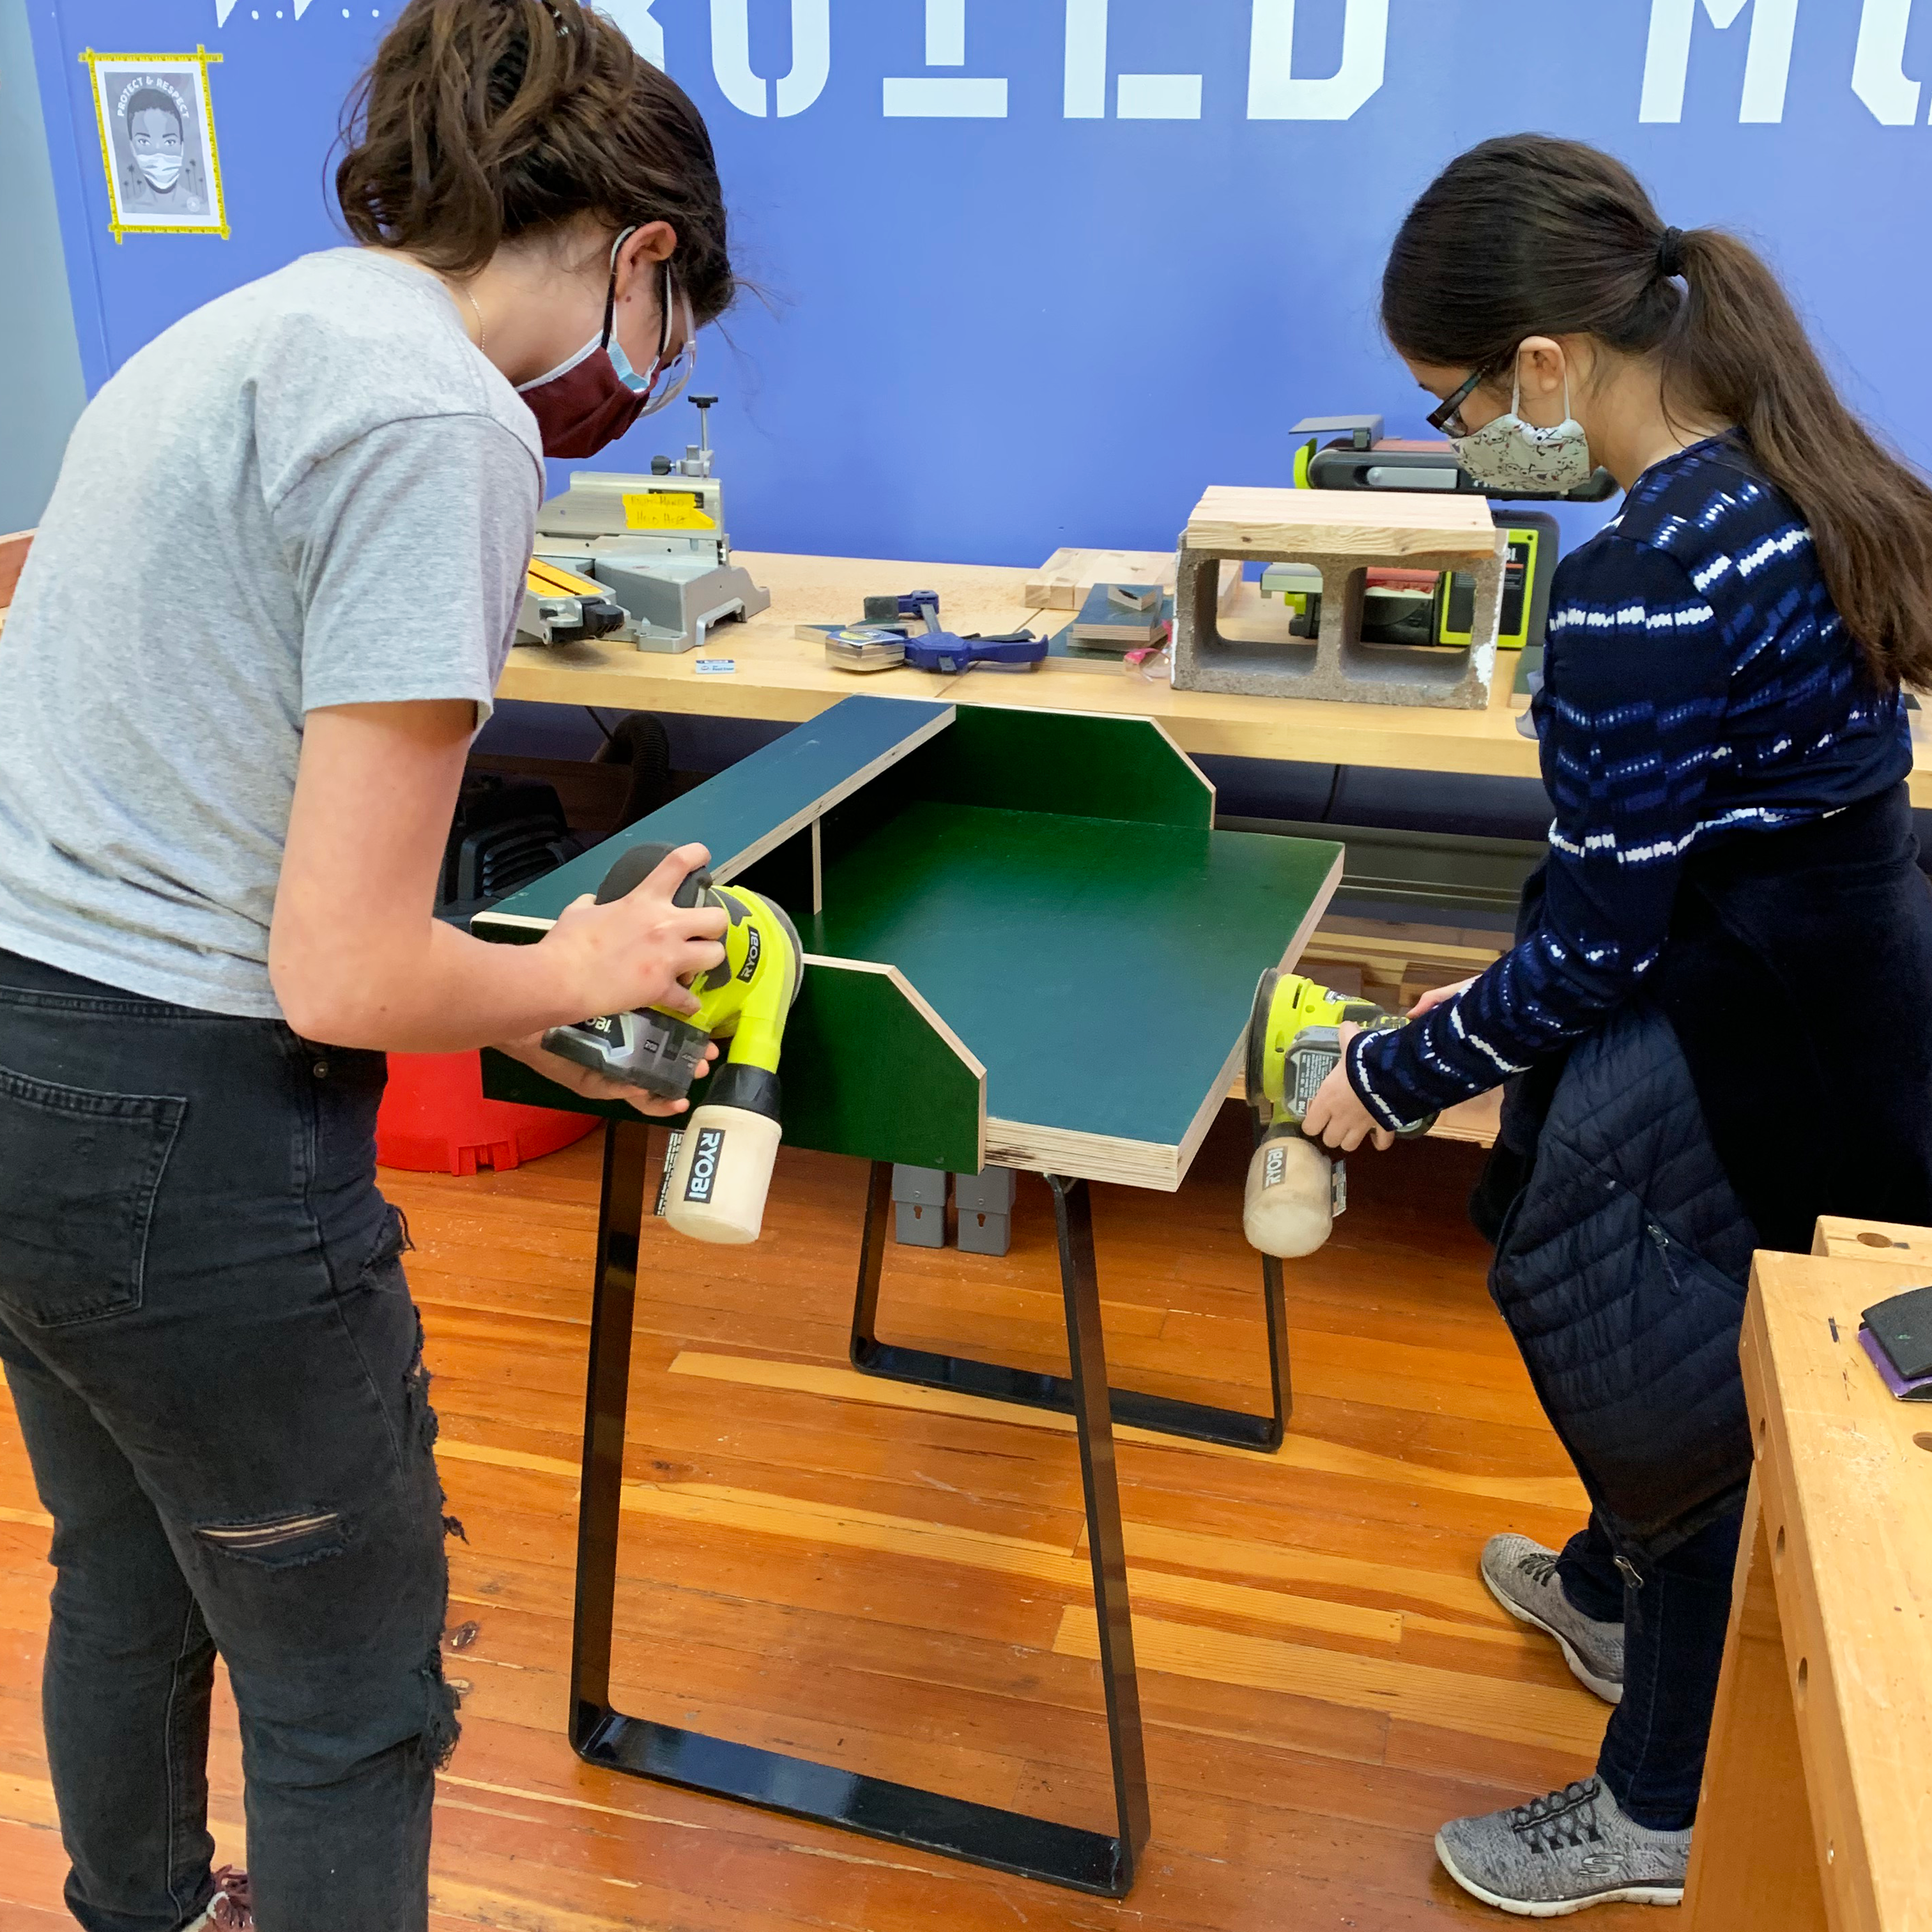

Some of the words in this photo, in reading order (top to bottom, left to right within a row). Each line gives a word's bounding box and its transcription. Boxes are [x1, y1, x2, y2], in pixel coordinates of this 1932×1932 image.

[117, 77, 143, 117] PROTECT
[146, 76, 153, 85] &
[157, 77, 190, 118] RESPECT
[740, 931, 759, 977] RYOBI
[689, 1132, 721, 1199] RYOBI
[1265, 1147, 1284, 1188] RYOBI
